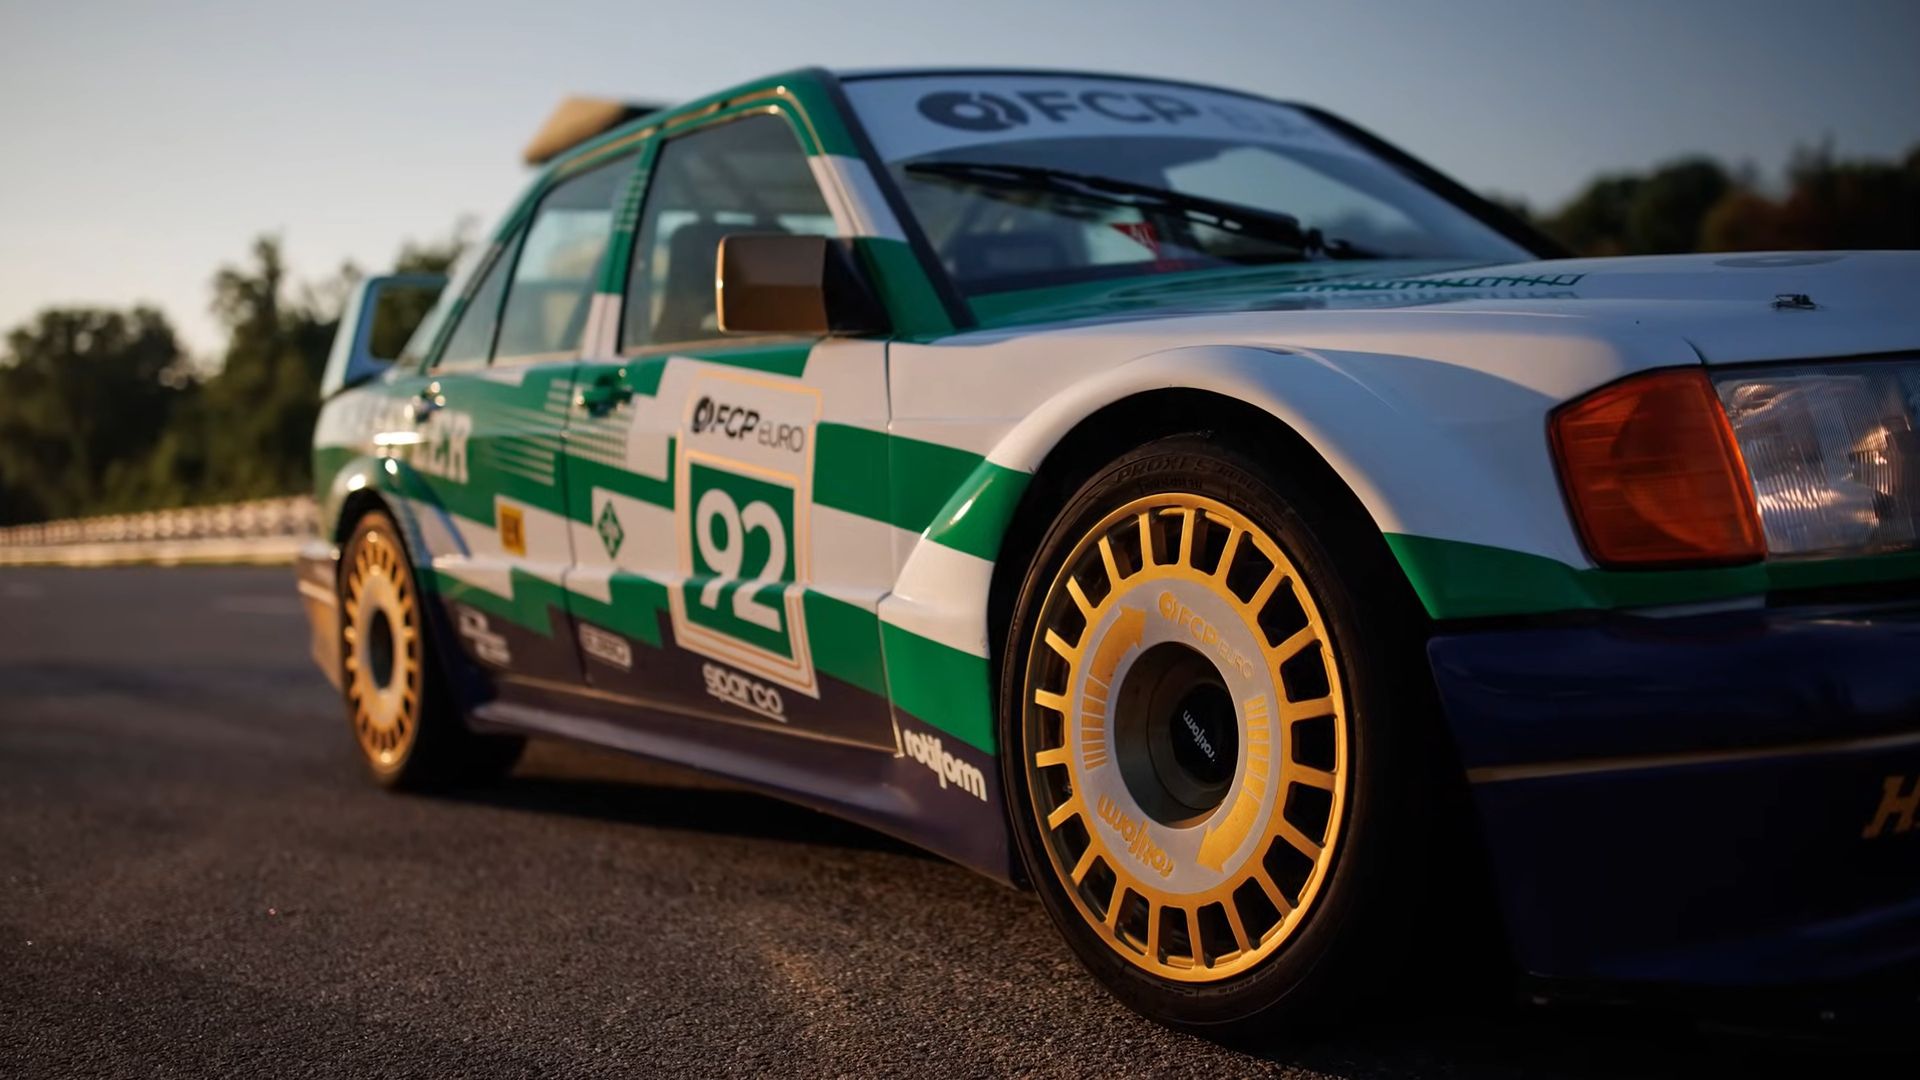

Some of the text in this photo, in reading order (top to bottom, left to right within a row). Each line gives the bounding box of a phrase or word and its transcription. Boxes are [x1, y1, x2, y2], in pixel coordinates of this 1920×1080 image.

[1020, 90, 1201, 125] FCP
[712, 404, 804, 453] FCP EURO
[696, 488, 787, 632] 92
[1177, 604, 1254, 678] FCP EURO
[702, 664, 784, 715] sparco
[903, 729, 988, 802] rotiform
[1182, 709, 1215, 761] rotiform
[1097, 795, 1174, 879] rotiform
